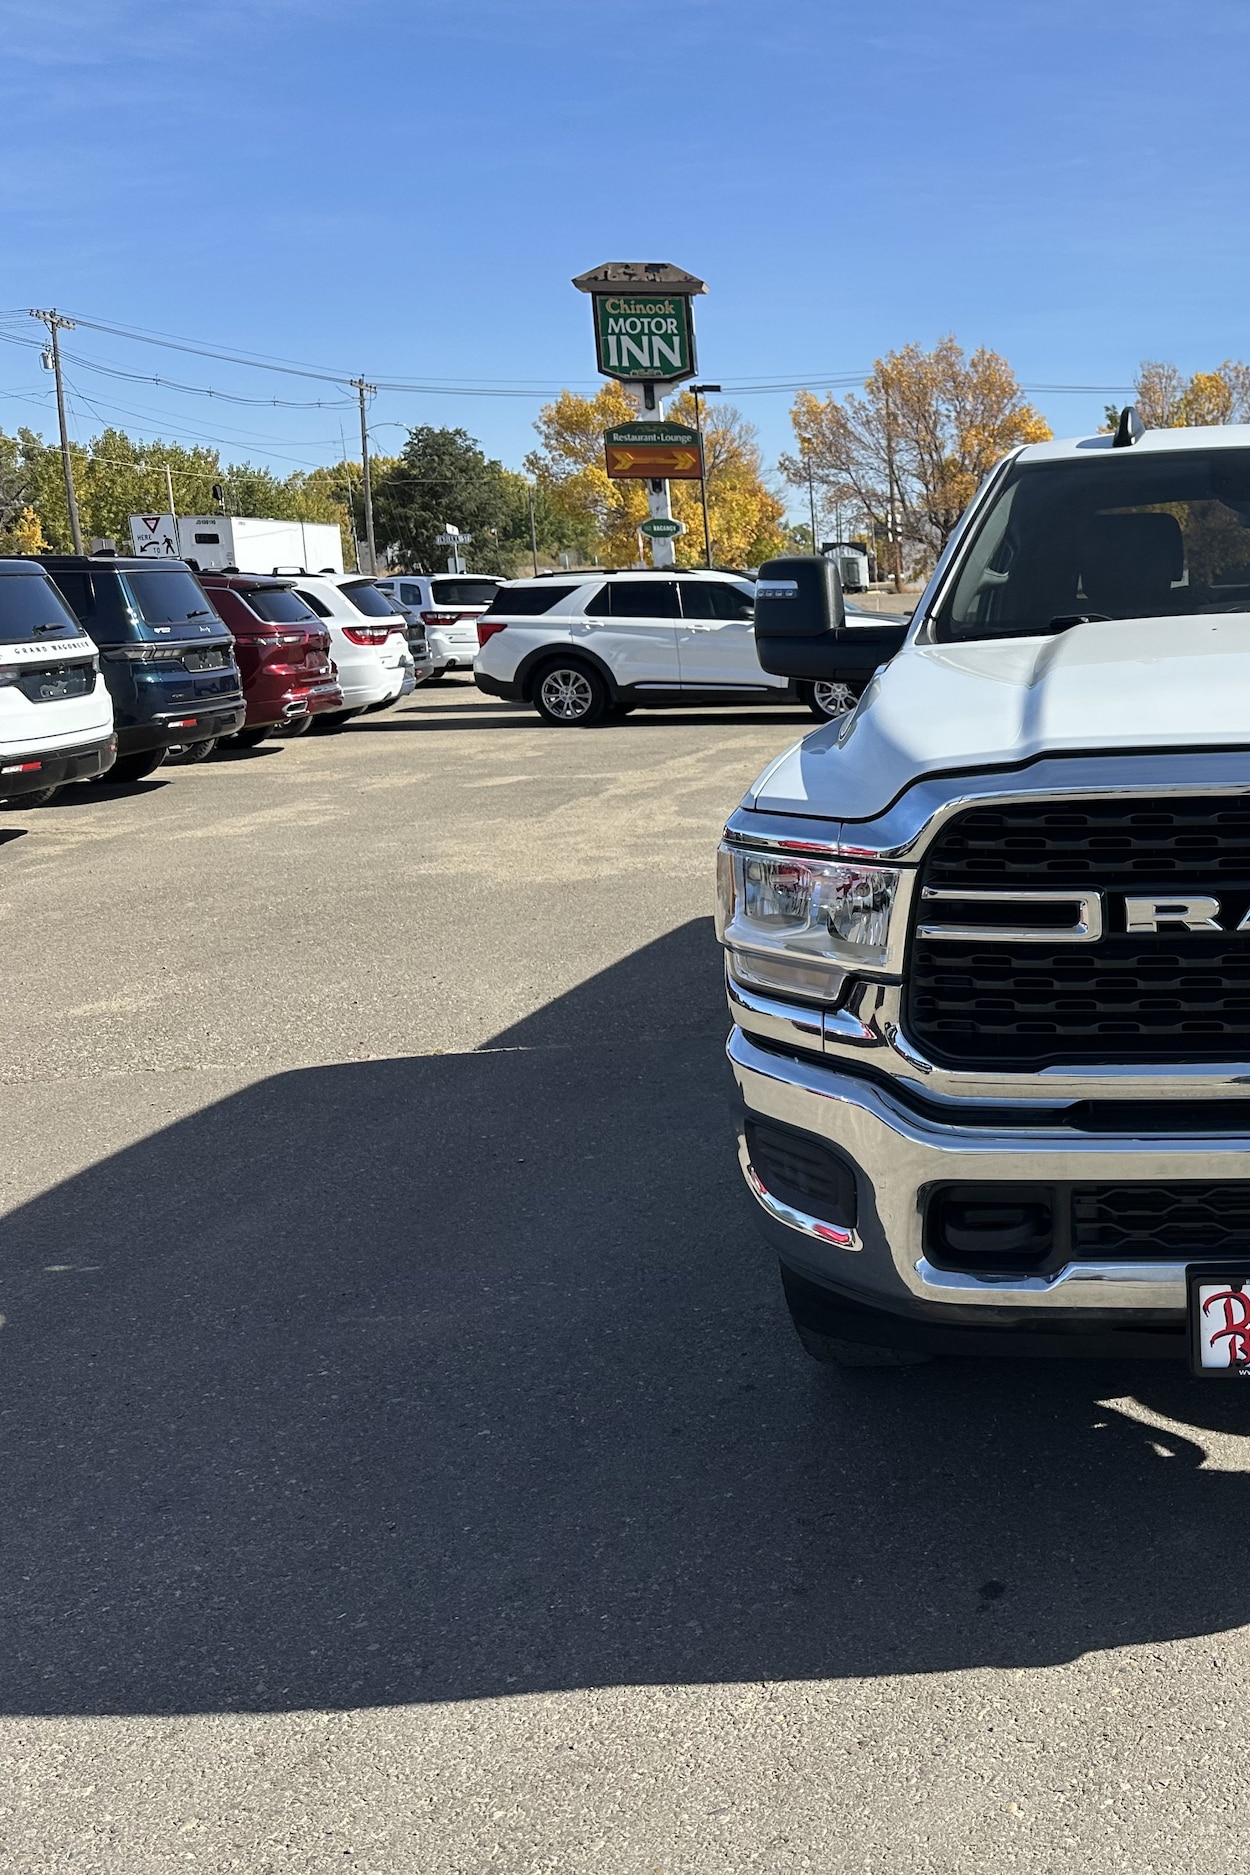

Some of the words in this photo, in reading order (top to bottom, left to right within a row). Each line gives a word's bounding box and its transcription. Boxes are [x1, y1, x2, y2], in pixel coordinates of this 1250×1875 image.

[605, 300, 675, 314] Chinook
[607, 317, 678, 335] MOTOR
[607, 334, 682, 367] INN
[14, 646, 47, 655] GRAND
